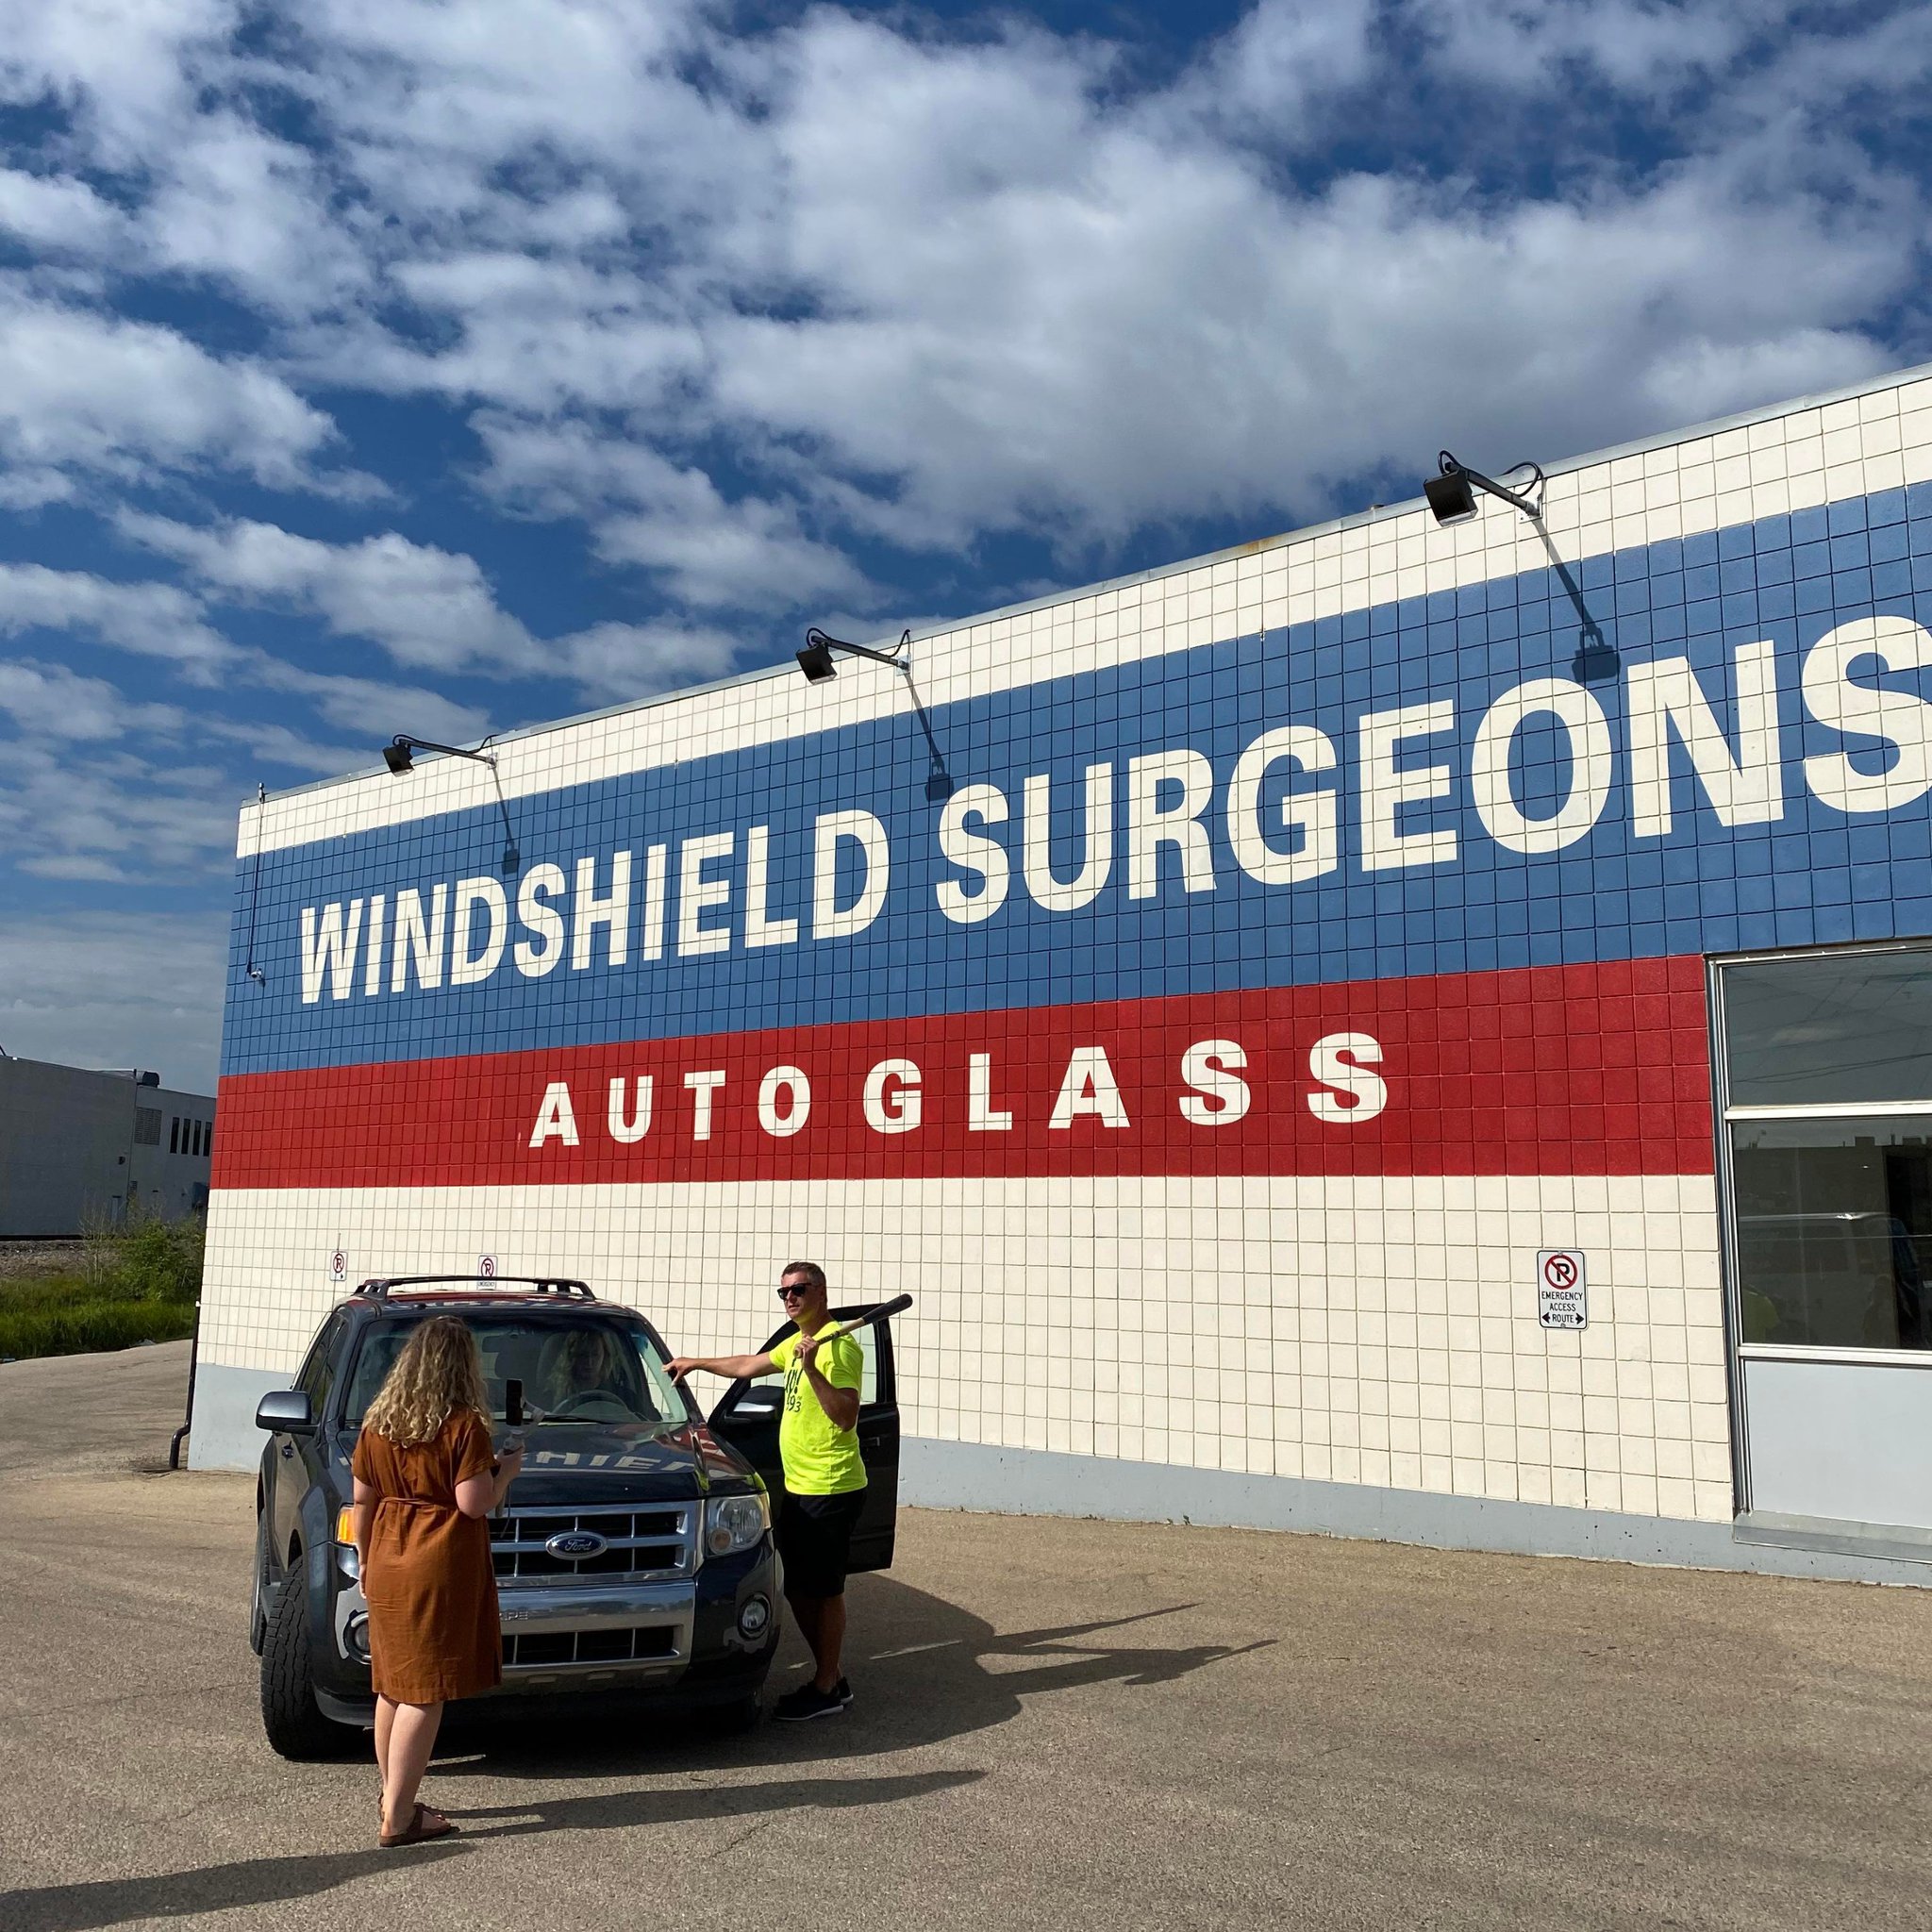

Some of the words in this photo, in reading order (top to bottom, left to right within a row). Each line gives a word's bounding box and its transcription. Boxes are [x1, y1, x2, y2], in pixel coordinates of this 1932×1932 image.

[301, 809, 890, 1005] WINDSHIELD
[935, 615, 1932, 924] SURGEONS
[528, 1065, 810, 1148] AUTO
[862, 1032, 1388, 1134] GLASS
[1541, 1291, 1583, 1301] EMERGENCY
[1549, 1303, 1576, 1312] ACCESS
[1552, 1314, 1574, 1324] ROUTE
[565, 1539, 592, 1552] Ford
